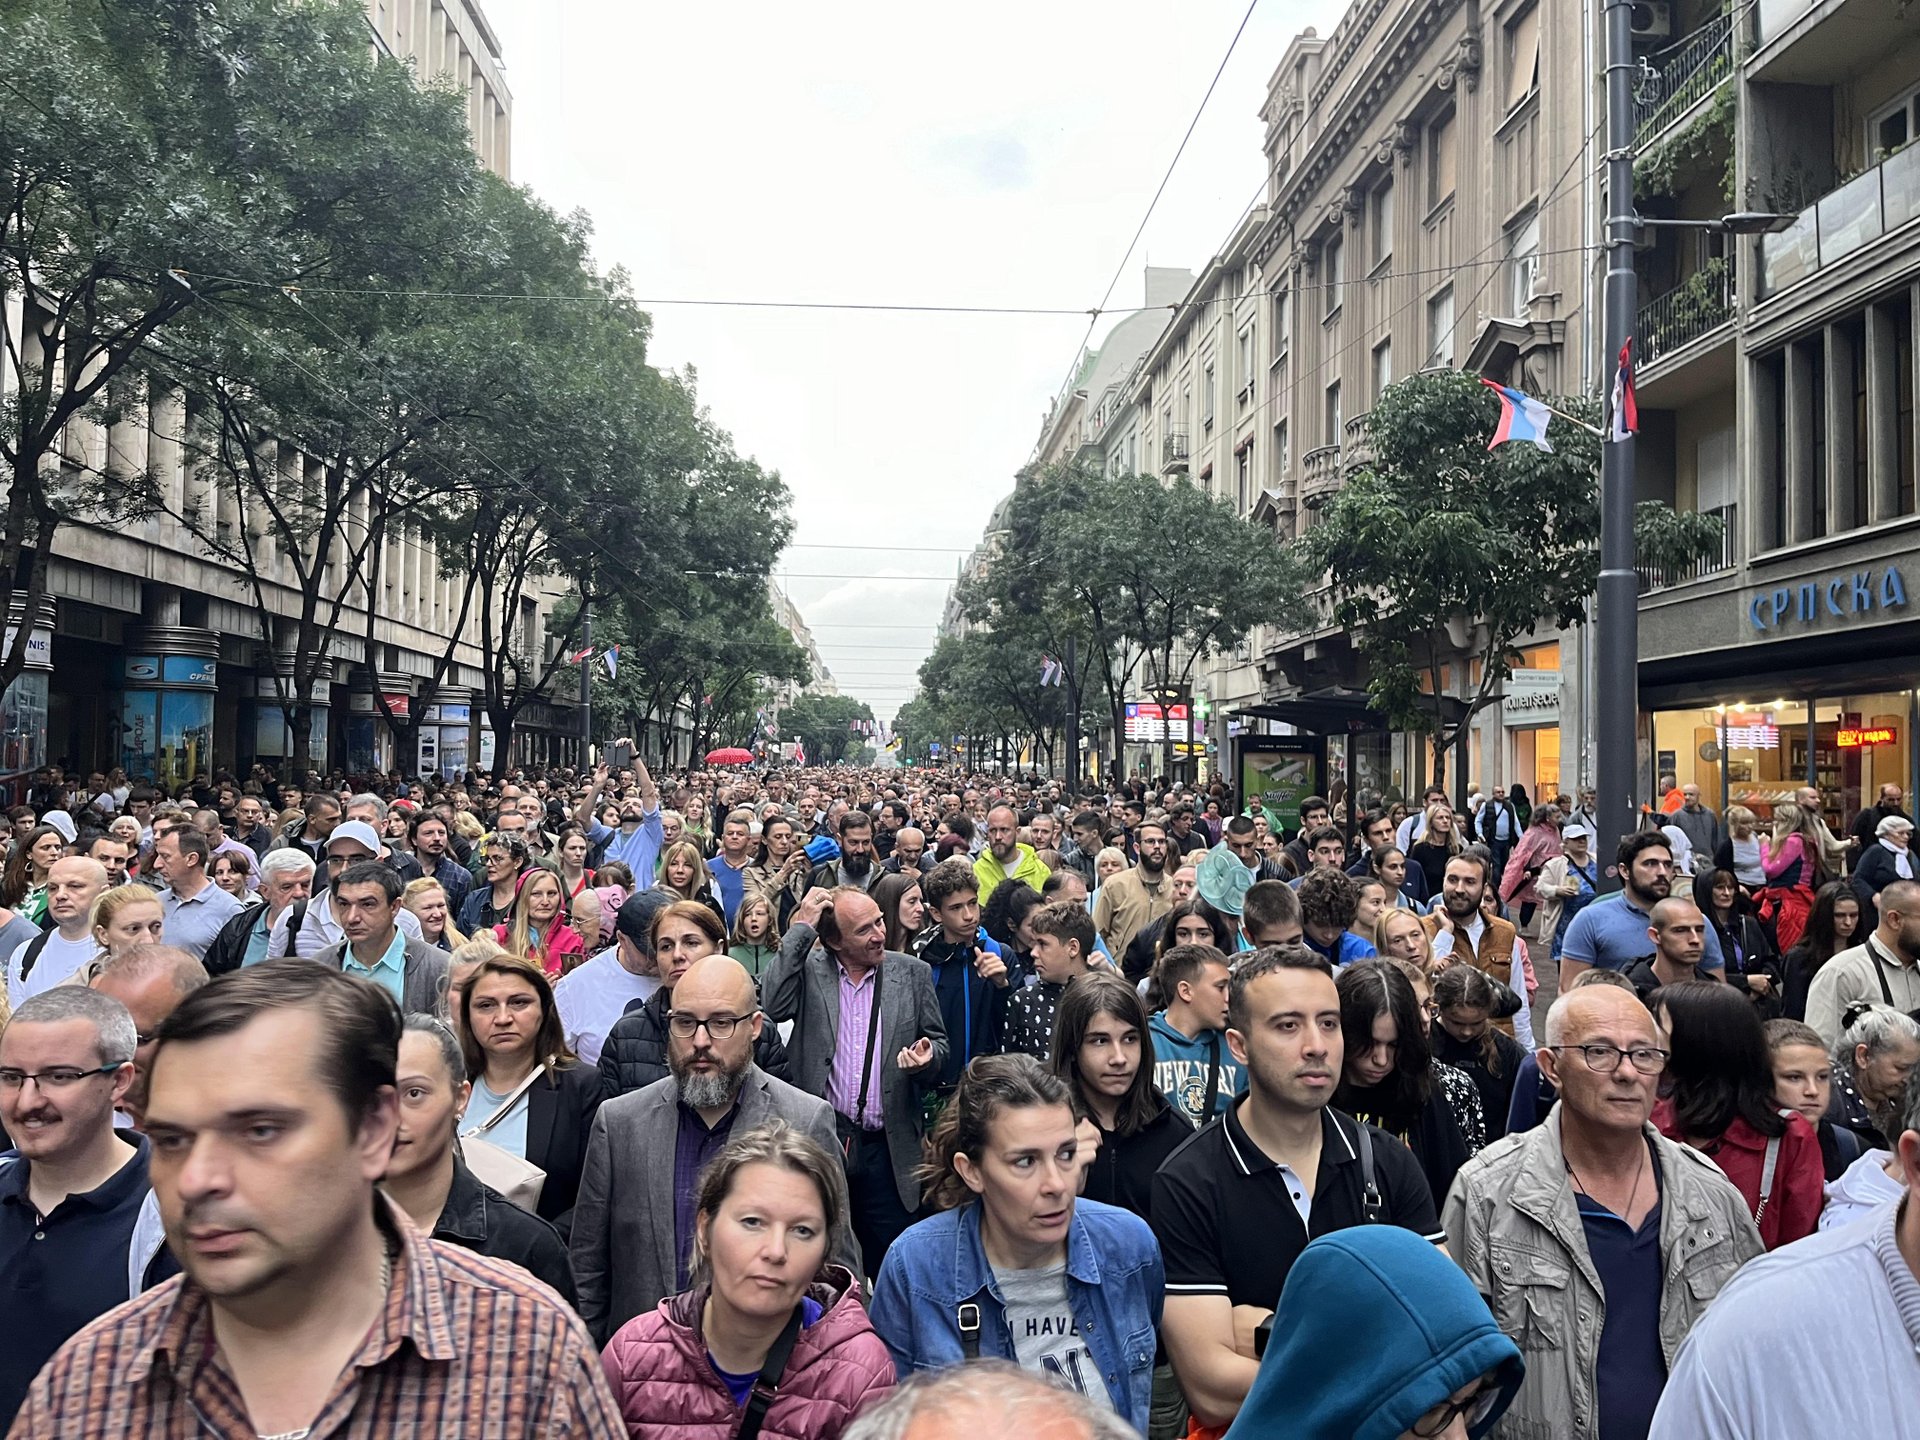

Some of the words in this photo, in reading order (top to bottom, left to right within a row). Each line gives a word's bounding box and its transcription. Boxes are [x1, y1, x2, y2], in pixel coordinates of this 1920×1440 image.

[1749, 566, 1906, 631] СРПСКА
[1153, 1061, 1191, 1094] NEW
[1026, 1316, 1079, 1337] HAVE
